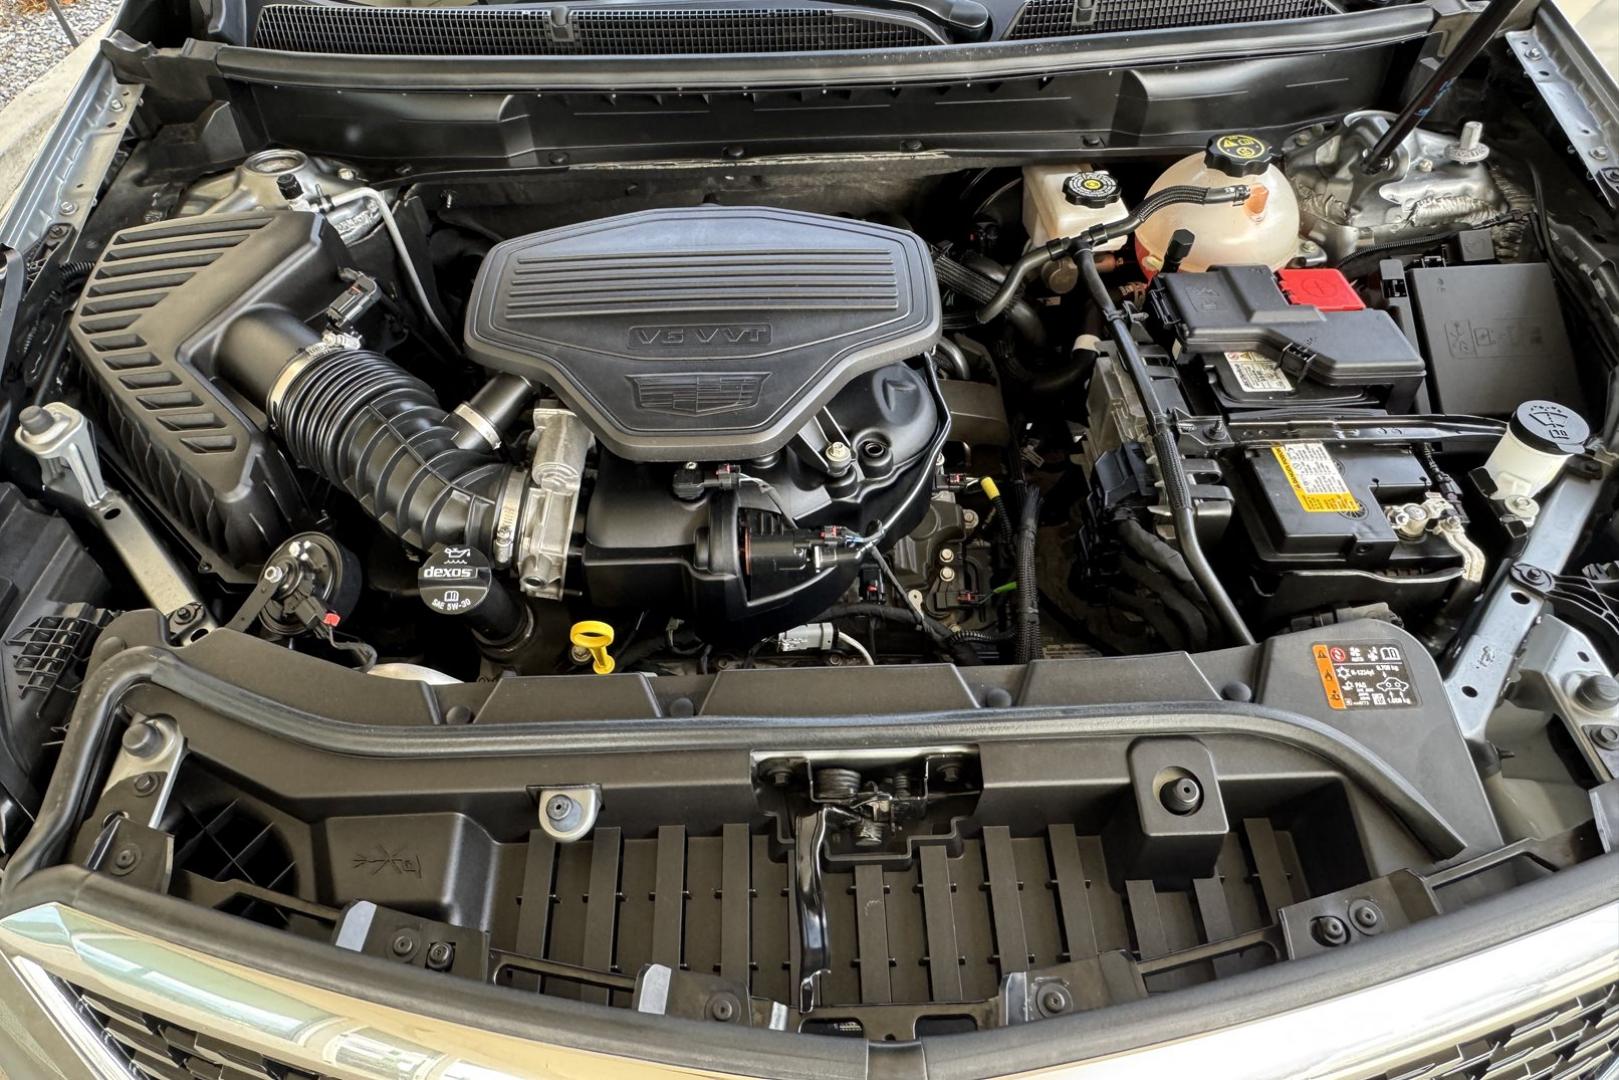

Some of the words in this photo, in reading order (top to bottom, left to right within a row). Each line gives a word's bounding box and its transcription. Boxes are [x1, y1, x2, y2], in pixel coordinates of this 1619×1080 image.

[695, 327, 767, 343] VVT
[423, 566, 473, 578] dexos
[431, 598, 446, 610] SAE
[446, 598, 471, 611] 5W-30
